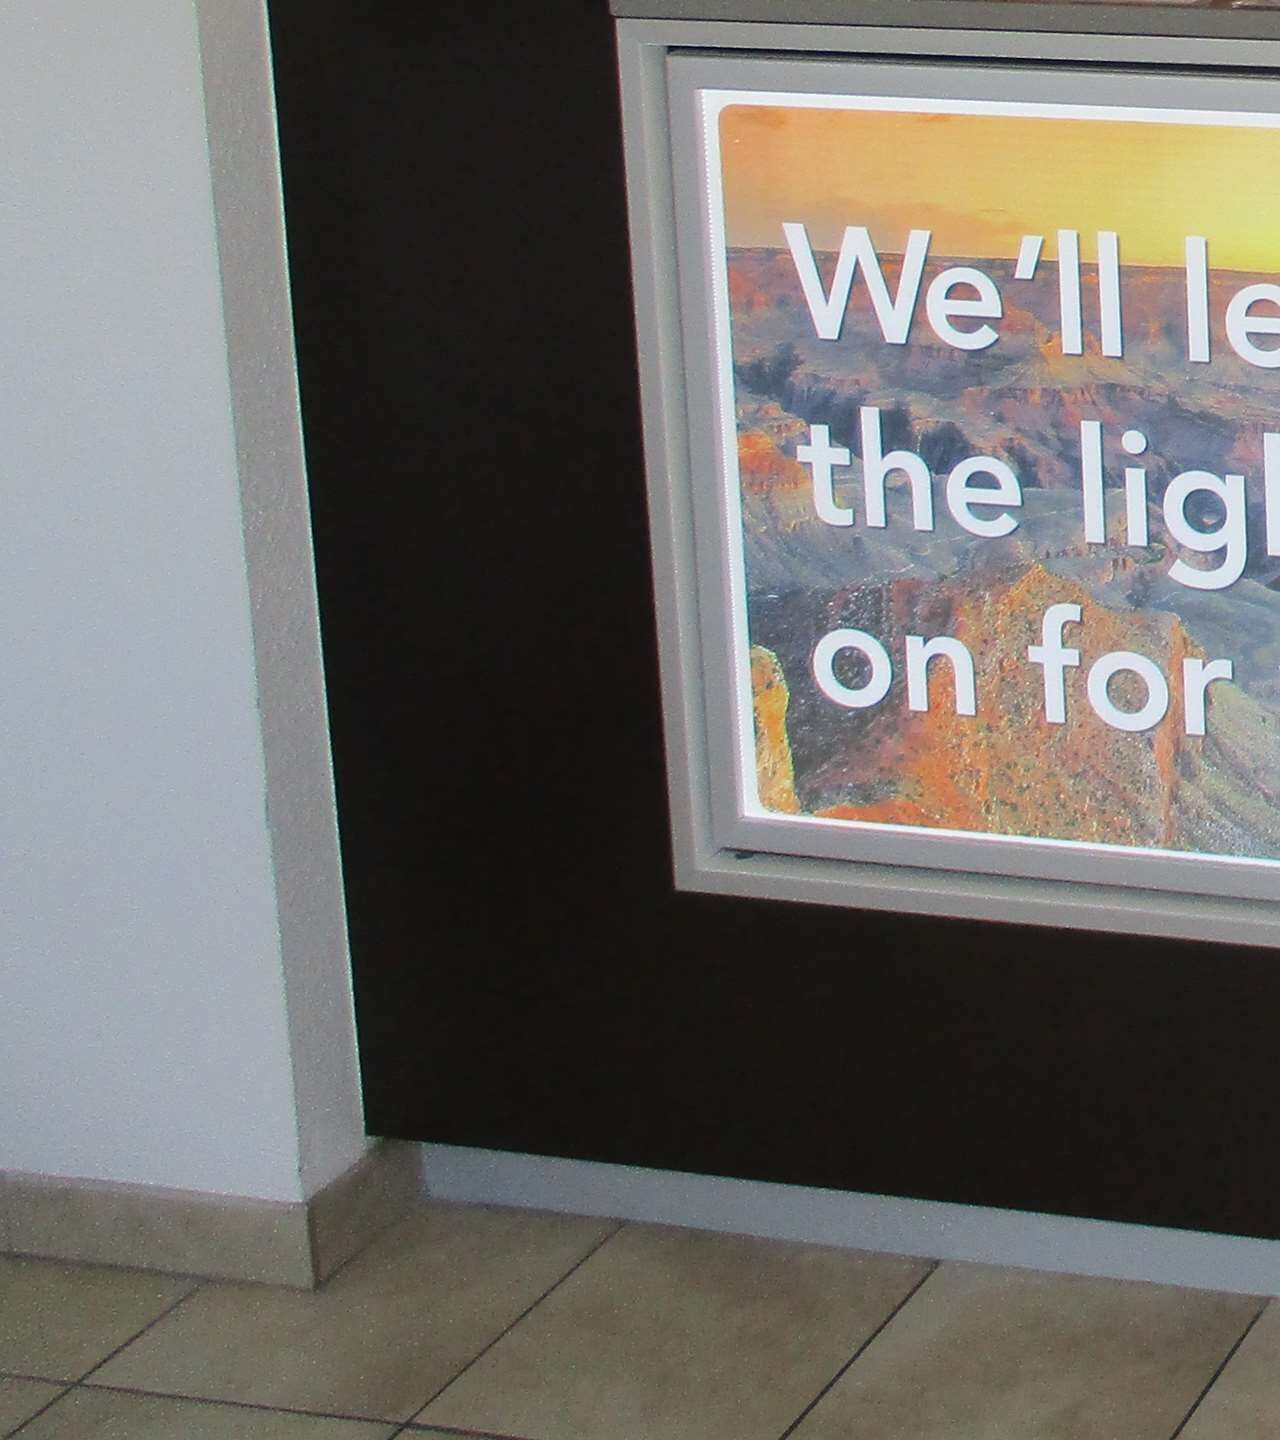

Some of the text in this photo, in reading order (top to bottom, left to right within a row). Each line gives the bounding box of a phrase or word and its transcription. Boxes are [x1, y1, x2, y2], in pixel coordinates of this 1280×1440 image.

[782, 221, 1124, 359] We'll
[796, 406, 1023, 539] the
[811, 626, 979, 718] on
[1027, 602, 1234, 736] for
